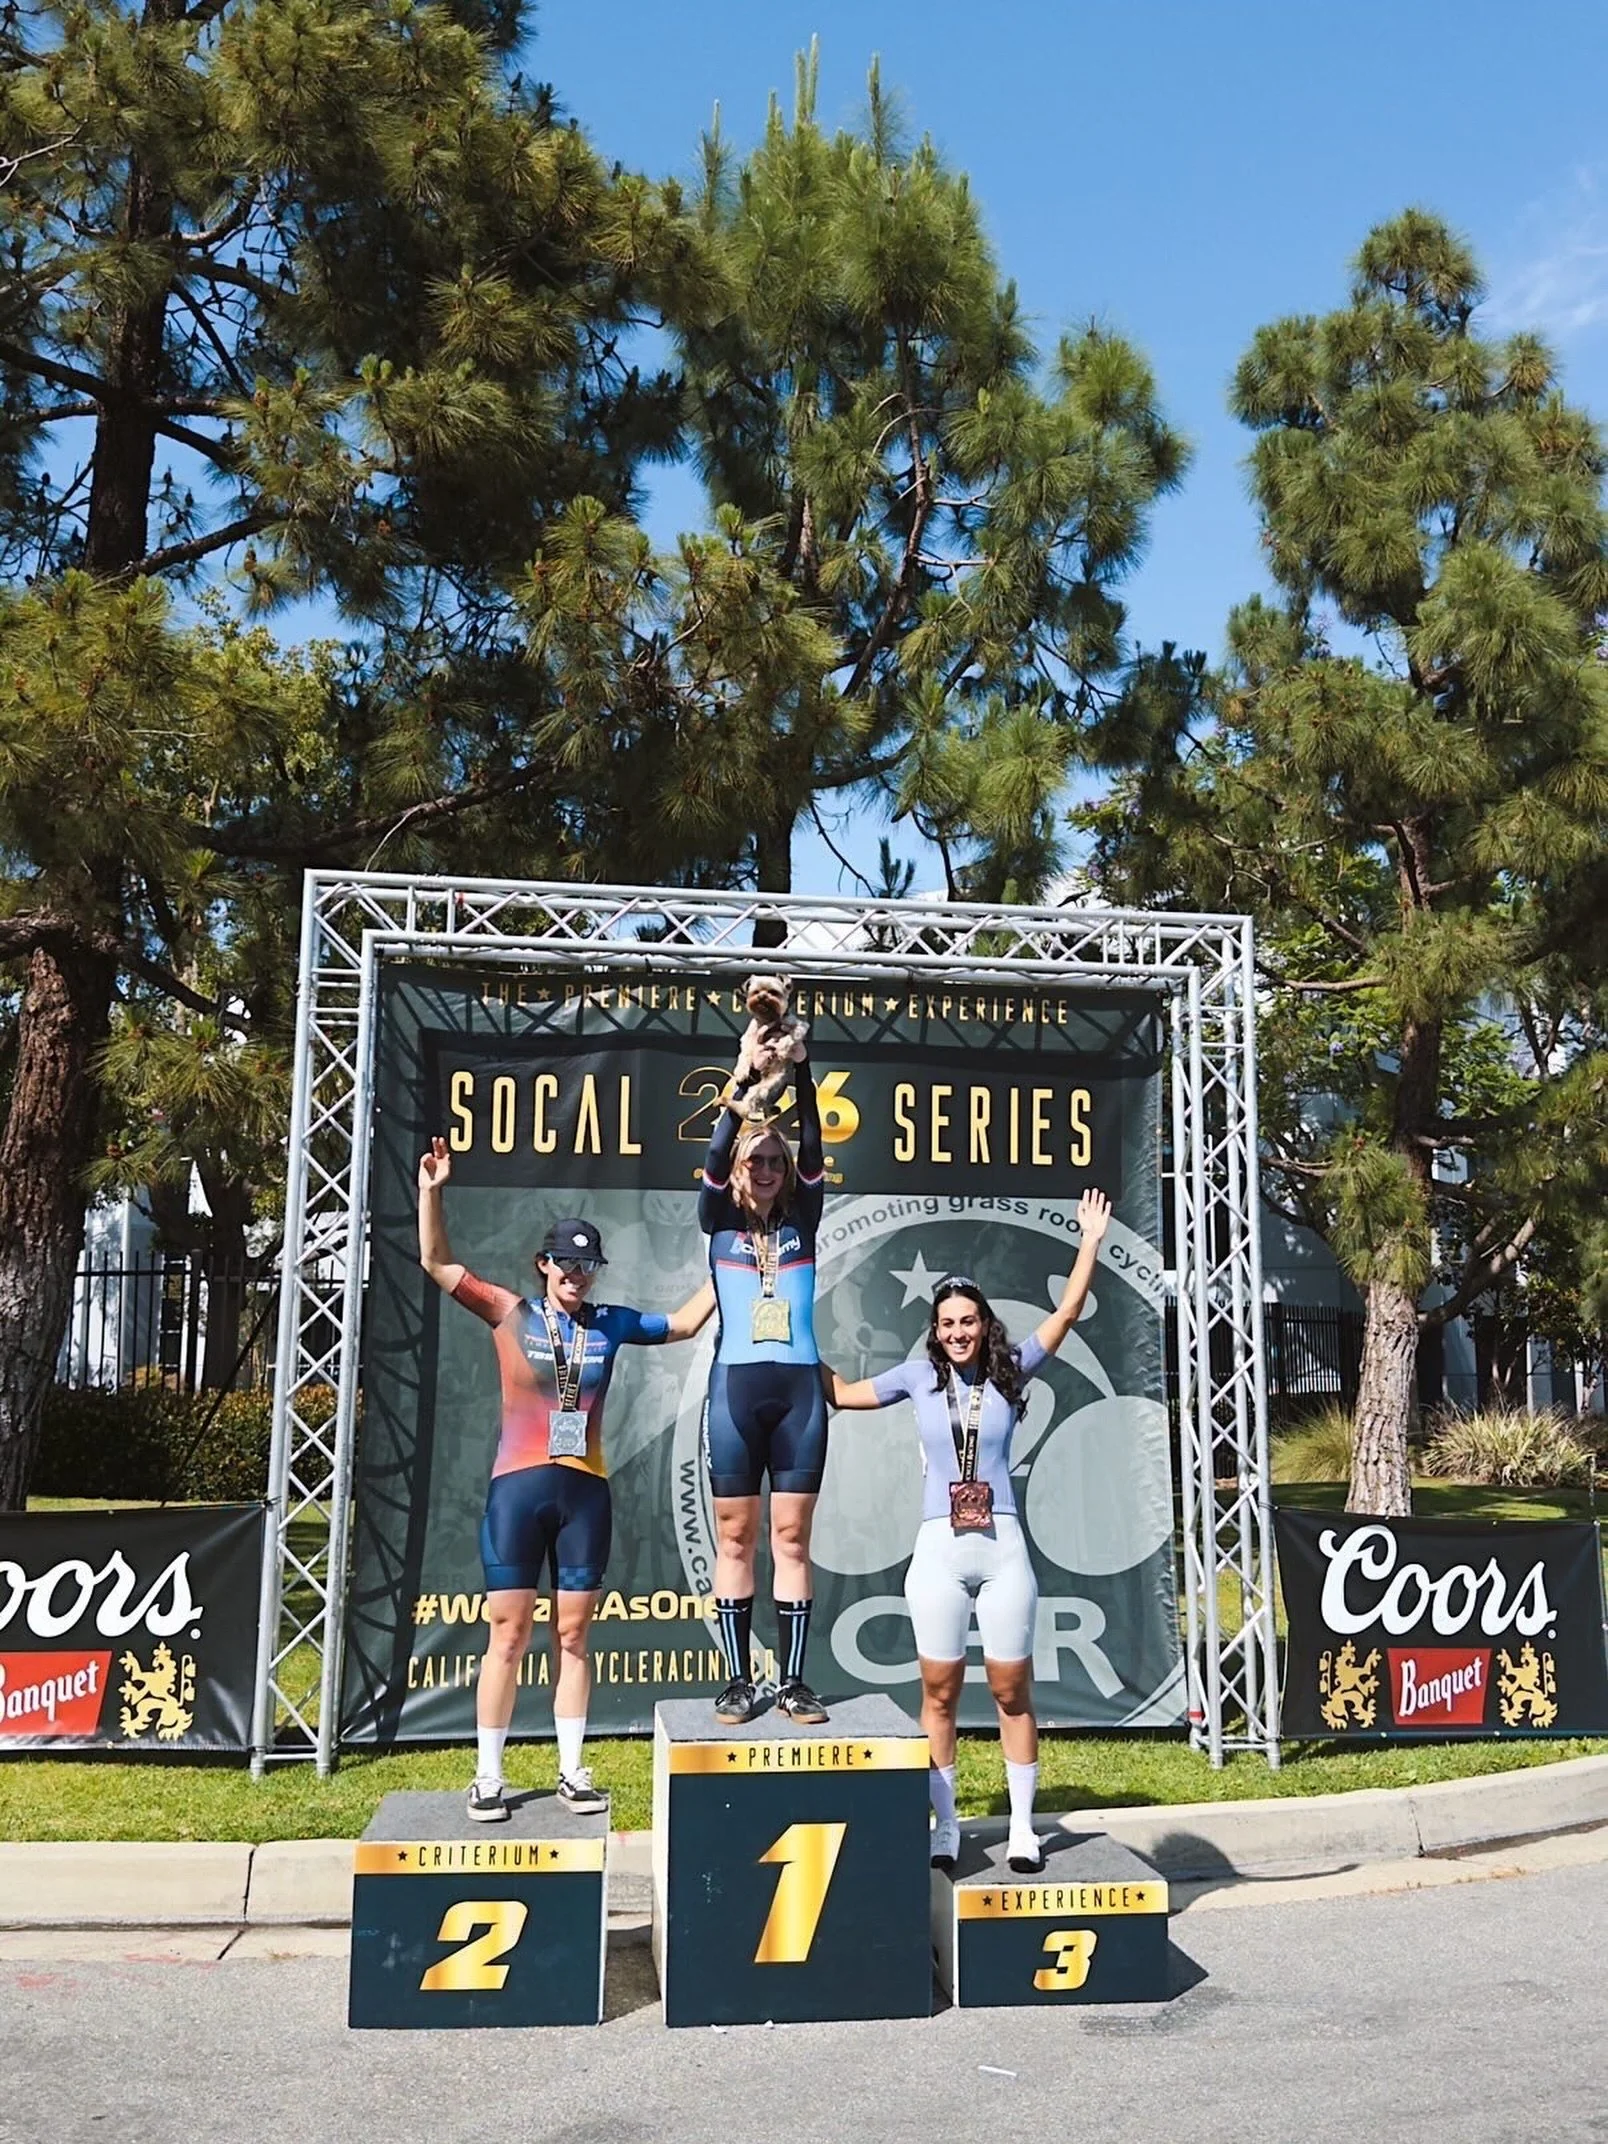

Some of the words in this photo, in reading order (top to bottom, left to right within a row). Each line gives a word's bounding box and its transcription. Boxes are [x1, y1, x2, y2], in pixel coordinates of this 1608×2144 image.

[481, 982, 527, 1006] THE
[564, 984, 697, 1012] PREMIERE
[732, 988, 874, 1017] CERIUM
[908, 993, 1068, 1024] EXPERIENCE
[450, 1071, 642, 1154] SOCAL
[894, 1083, 1092, 1167] SERIES
[949, 1195, 1029, 1215] grass
[1039, 1206, 1084, 1238] roo
[0, 1659, 99, 1722] anquet
[1399, 1656, 1484, 1717] Banquet
[748, 1745, 854, 1767] PREMIERE
[418, 1845, 540, 1867] CRITERIUM
[754, 1822, 847, 1964] 1
[1001, 1887, 1130, 1911] EXPERIENCE
[418, 1900, 529, 1991] 2
[1033, 1929, 1098, 1991] 3
